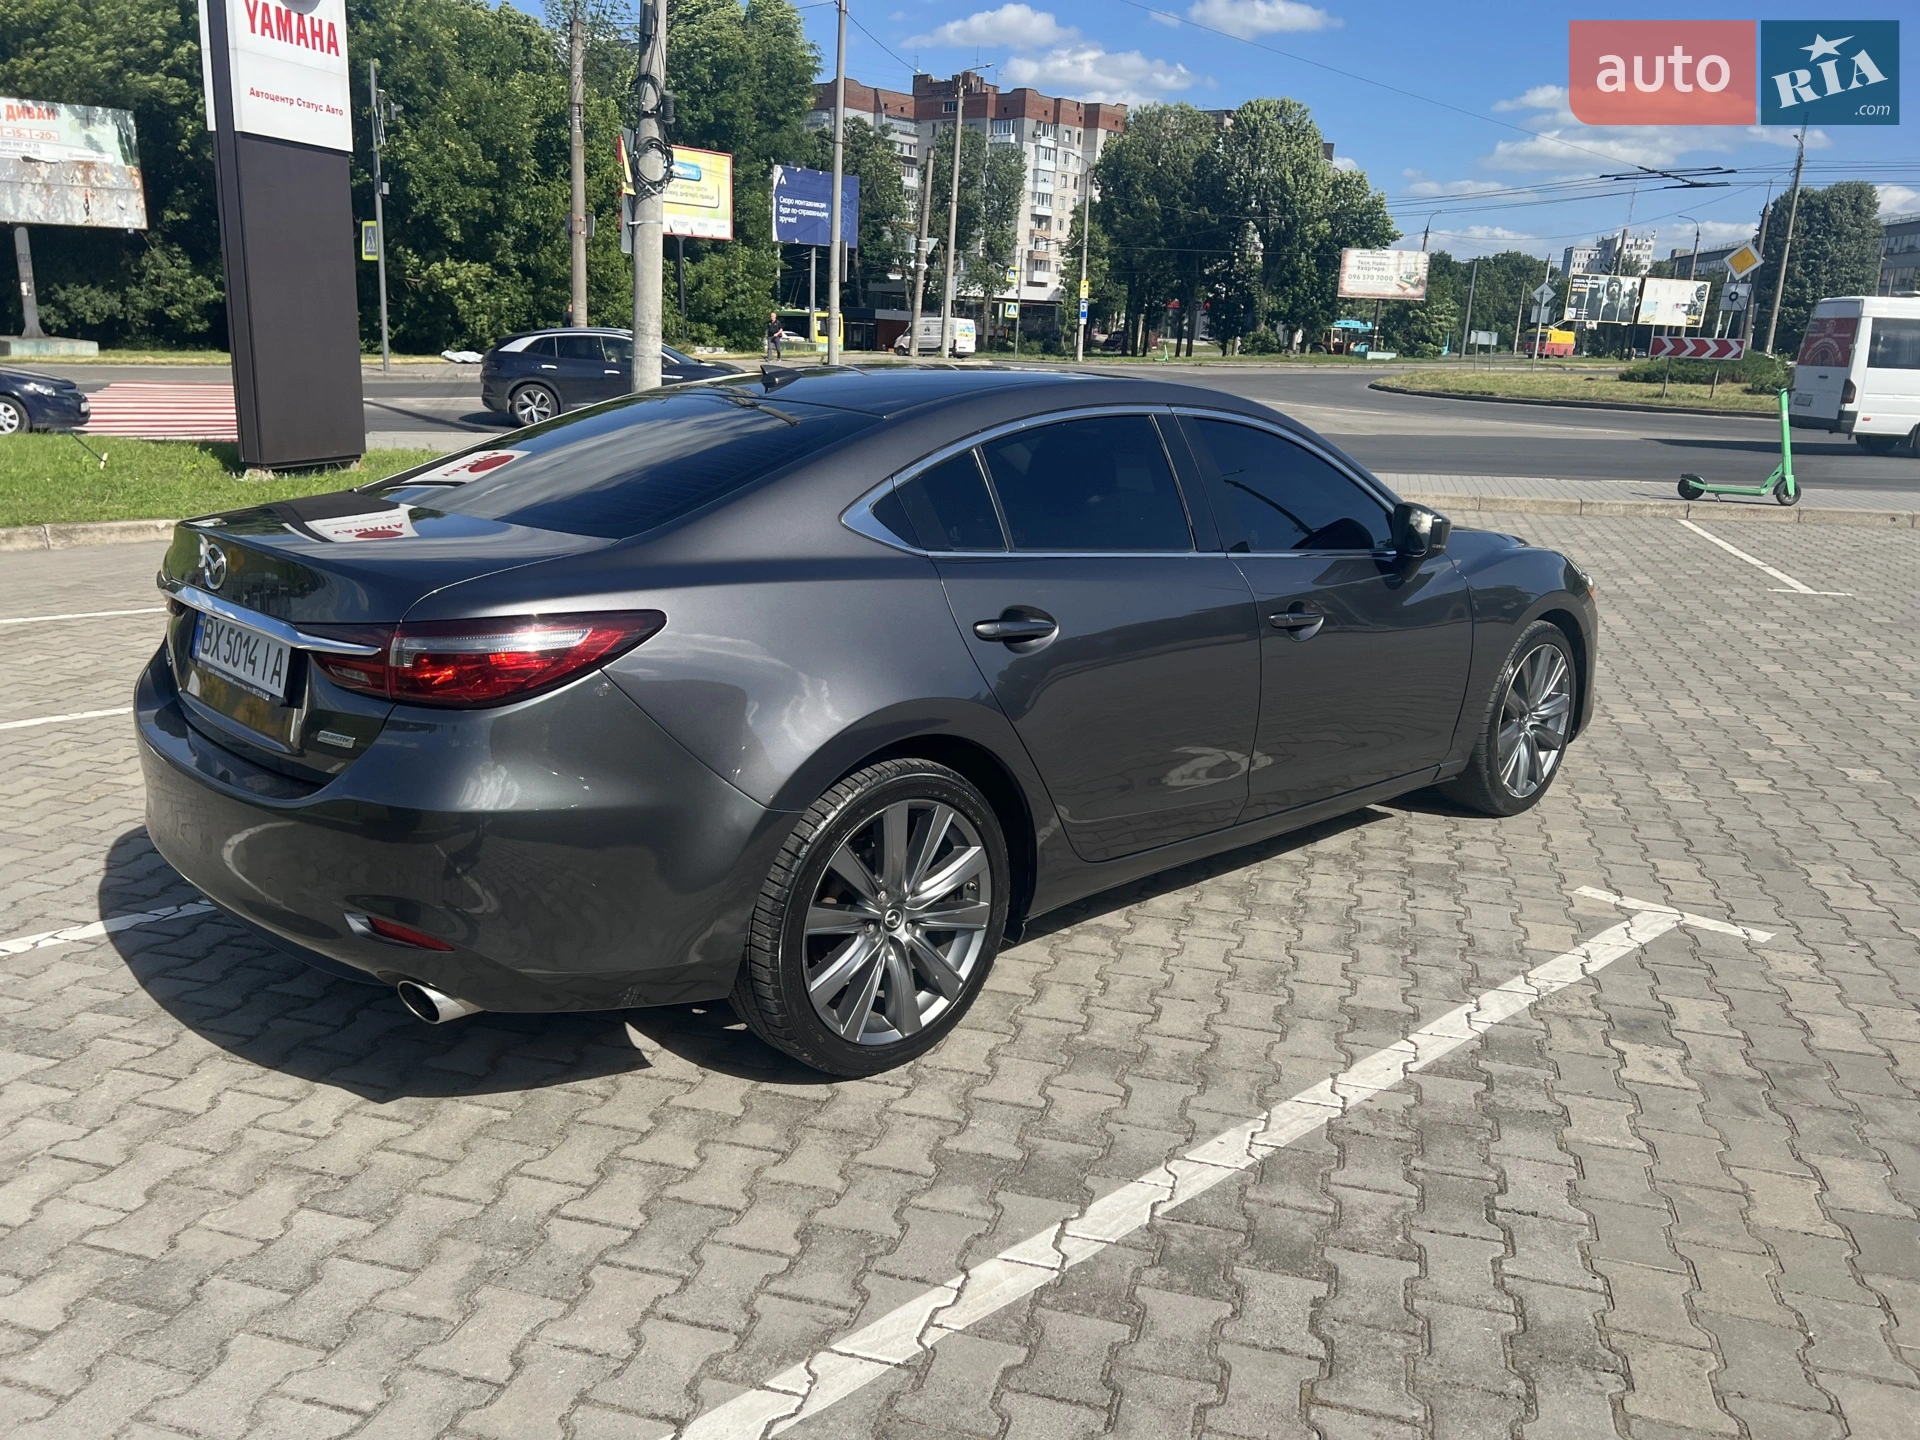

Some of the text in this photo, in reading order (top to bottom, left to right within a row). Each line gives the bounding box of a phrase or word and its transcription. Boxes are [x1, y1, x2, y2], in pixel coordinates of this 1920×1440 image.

[244, 0, 340, 57] YAMAHA
[249, 86, 344, 116] Автоцентр Статус Авто
